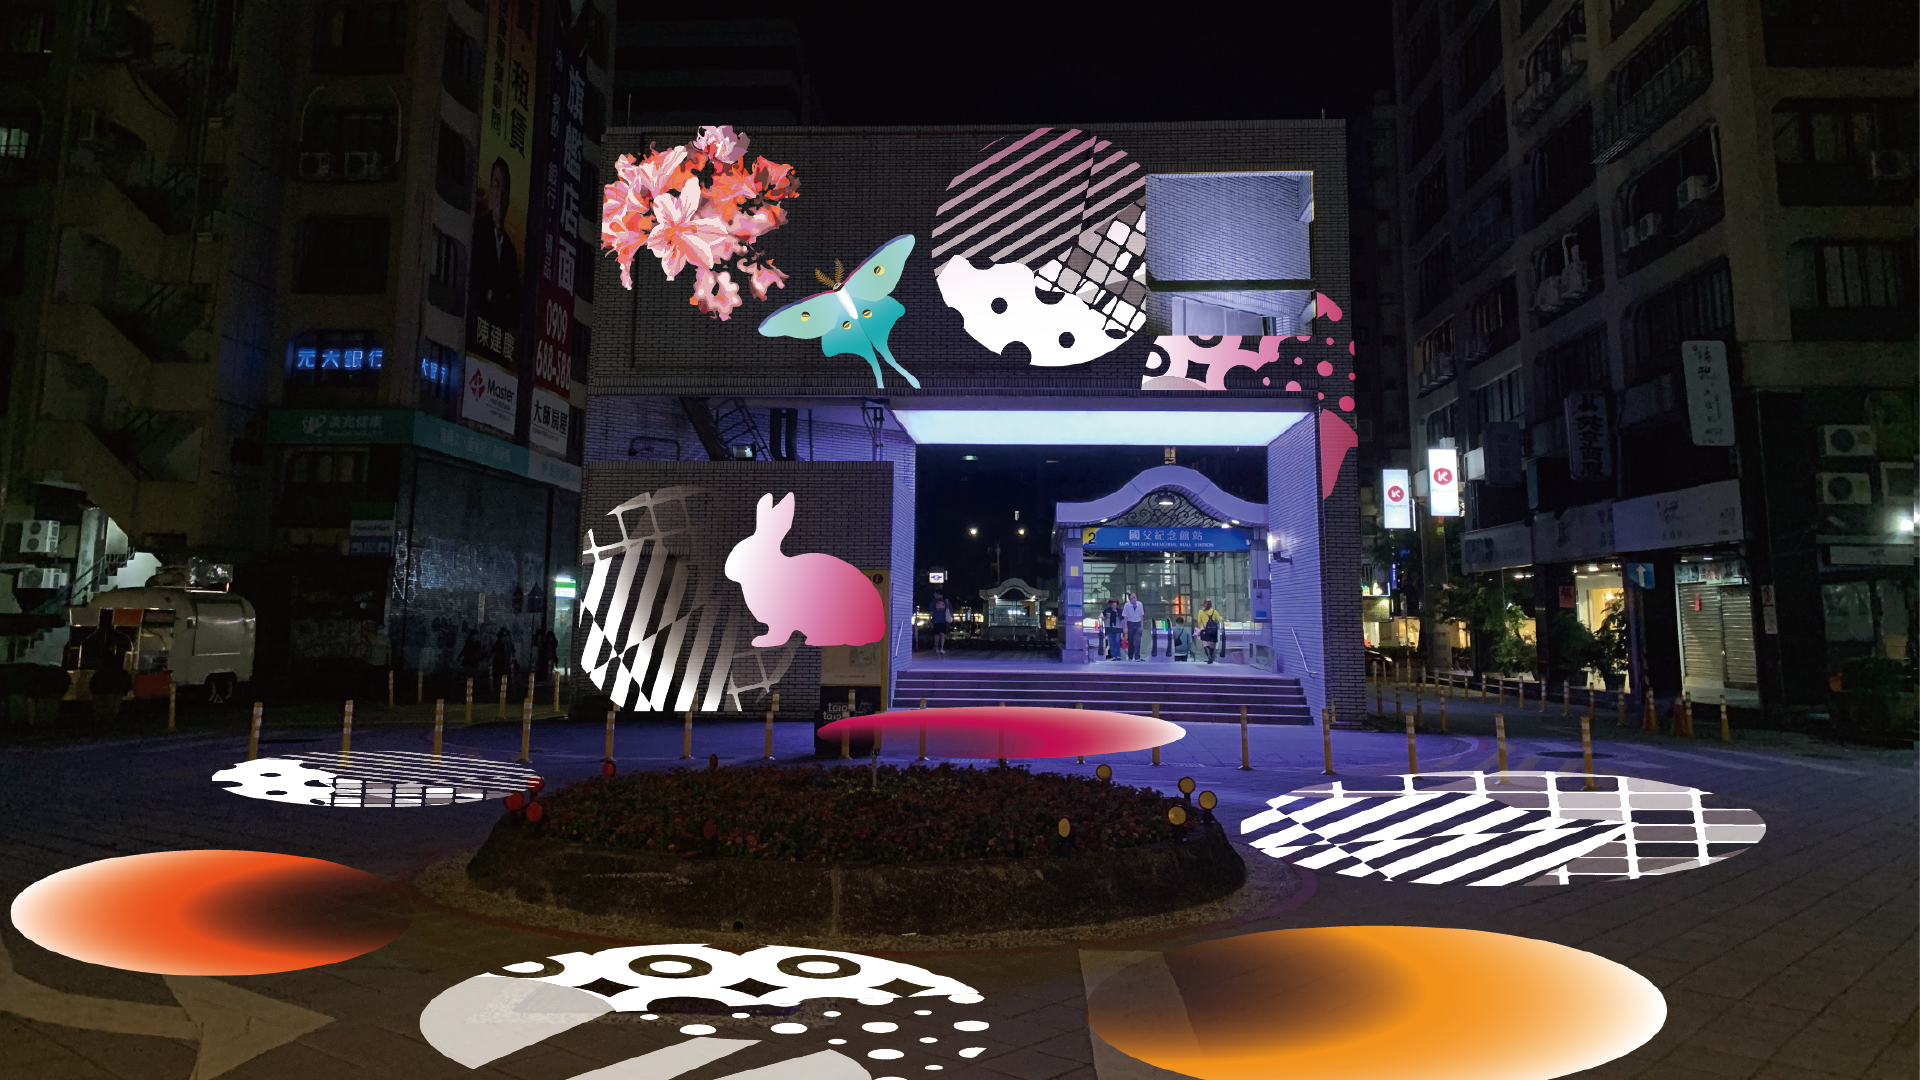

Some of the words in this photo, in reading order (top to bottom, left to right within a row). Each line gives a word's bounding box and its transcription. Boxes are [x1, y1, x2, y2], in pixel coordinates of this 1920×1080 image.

[558, 64, 586, 297] 旗艦店面
[476, 315, 515, 361] 陳建慶
[546, 298, 569, 342] 0909
[296, 348, 384, 370] 元大銀行
[536, 339, 572, 391] 688-588
[487, 377, 514, 403] Master
[533, 399, 568, 436] 大師房屋
[1087, 532, 1096, 545] 2
[1128, 529, 1204, 541] 國父紀念館站
